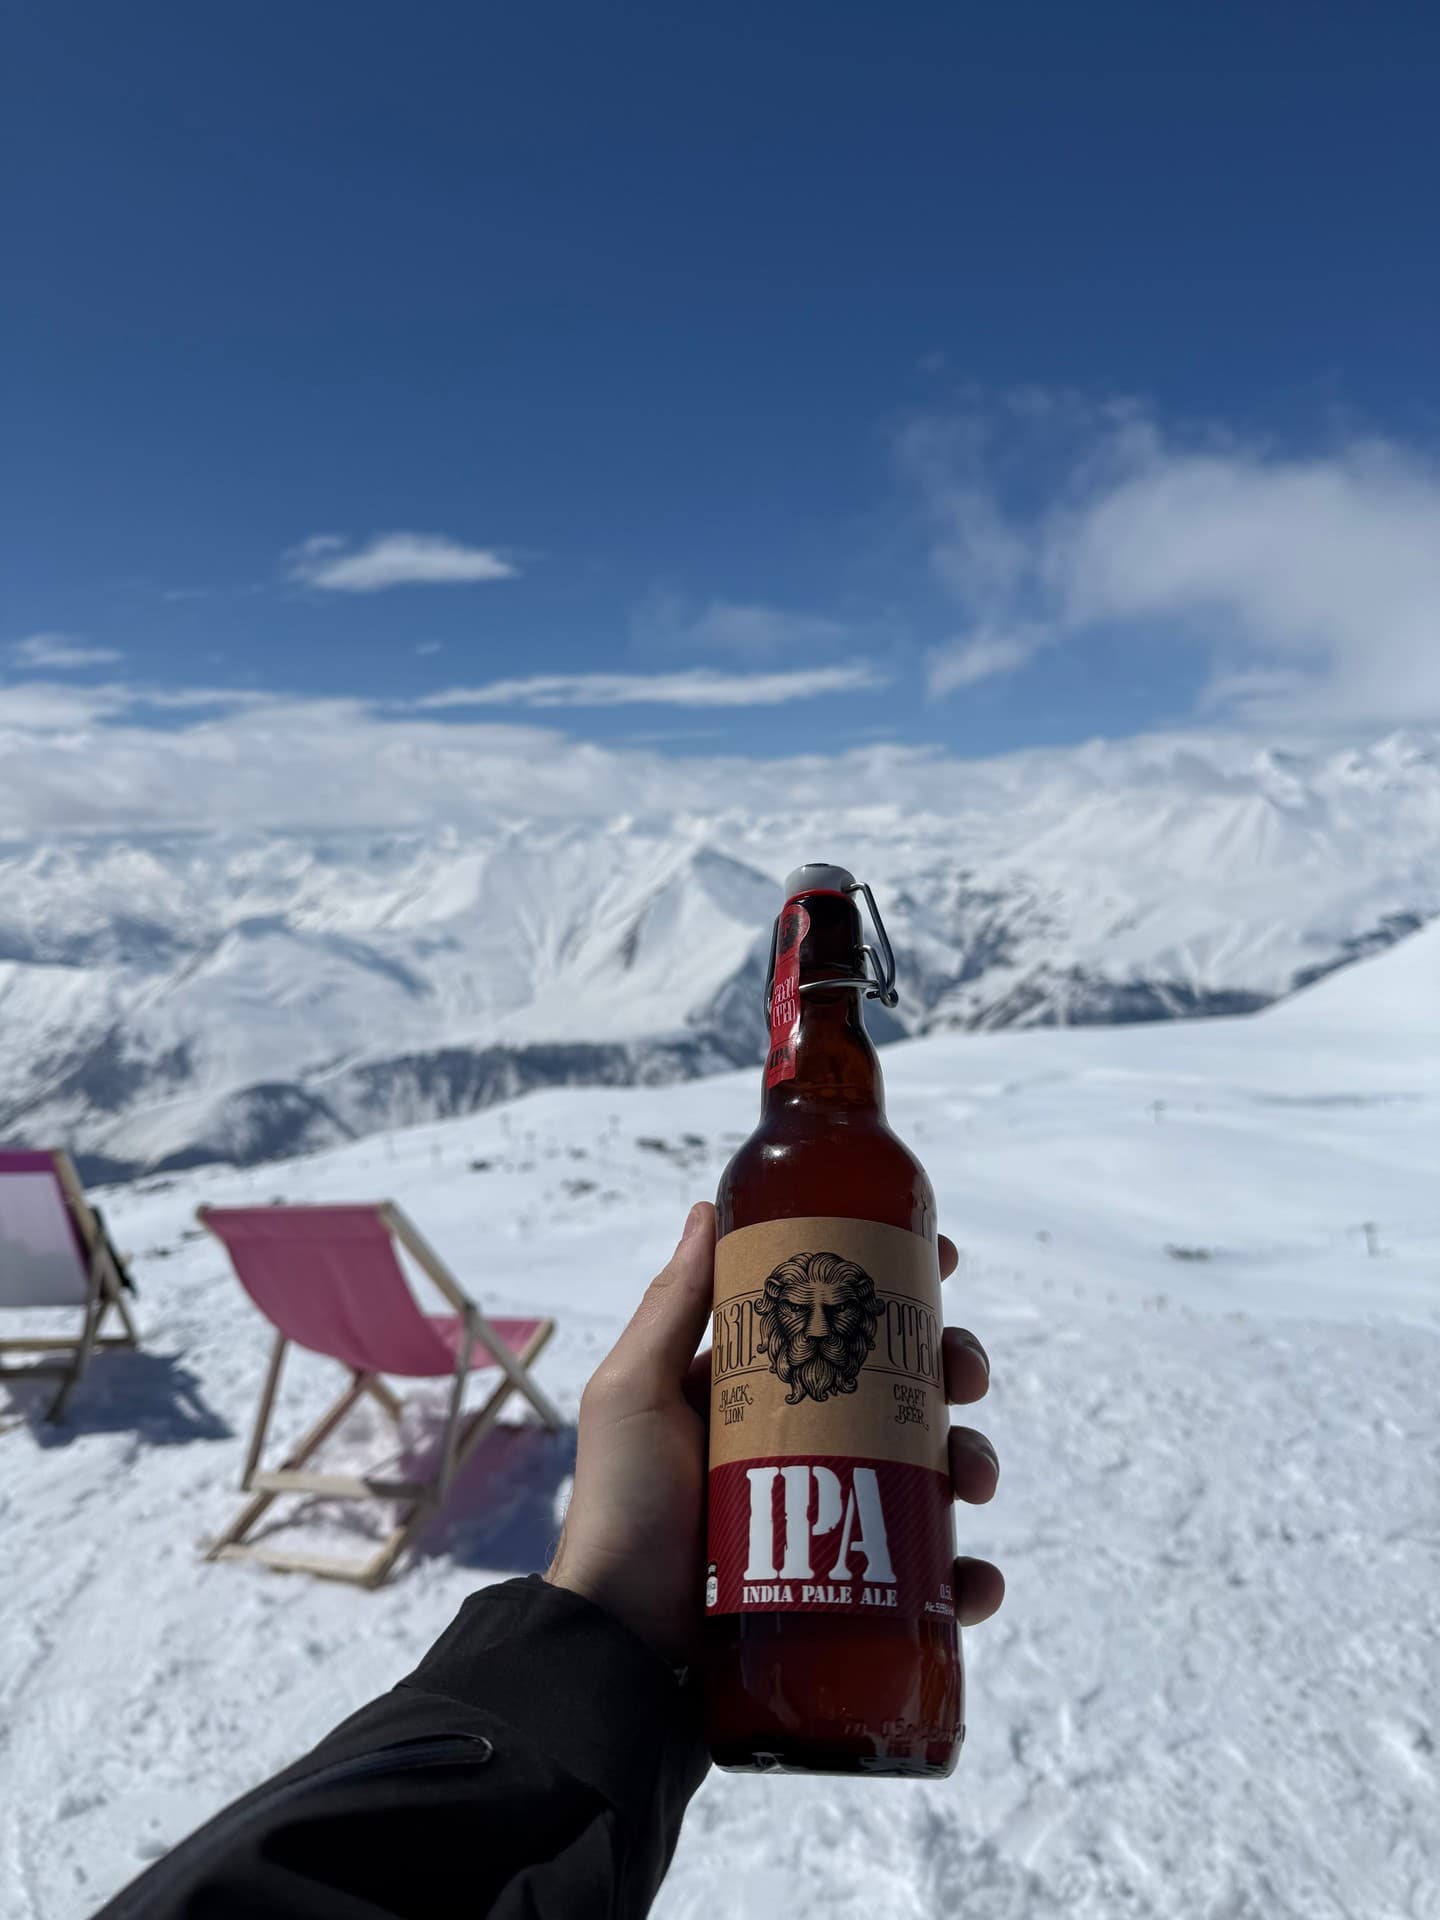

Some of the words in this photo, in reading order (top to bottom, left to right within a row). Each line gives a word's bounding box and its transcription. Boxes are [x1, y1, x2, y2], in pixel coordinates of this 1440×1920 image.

[719, 1383, 753, 1412] BLACK
[893, 1383, 927, 1408] CRAFT
[724, 1406, 744, 1426] LION
[895, 1404, 929, 1430] BEER
[743, 1465, 897, 1584] IPA
[742, 1585, 794, 1604] INDIA
[801, 1585, 852, 1605] PALE
[860, 1587, 898, 1607] ALE
